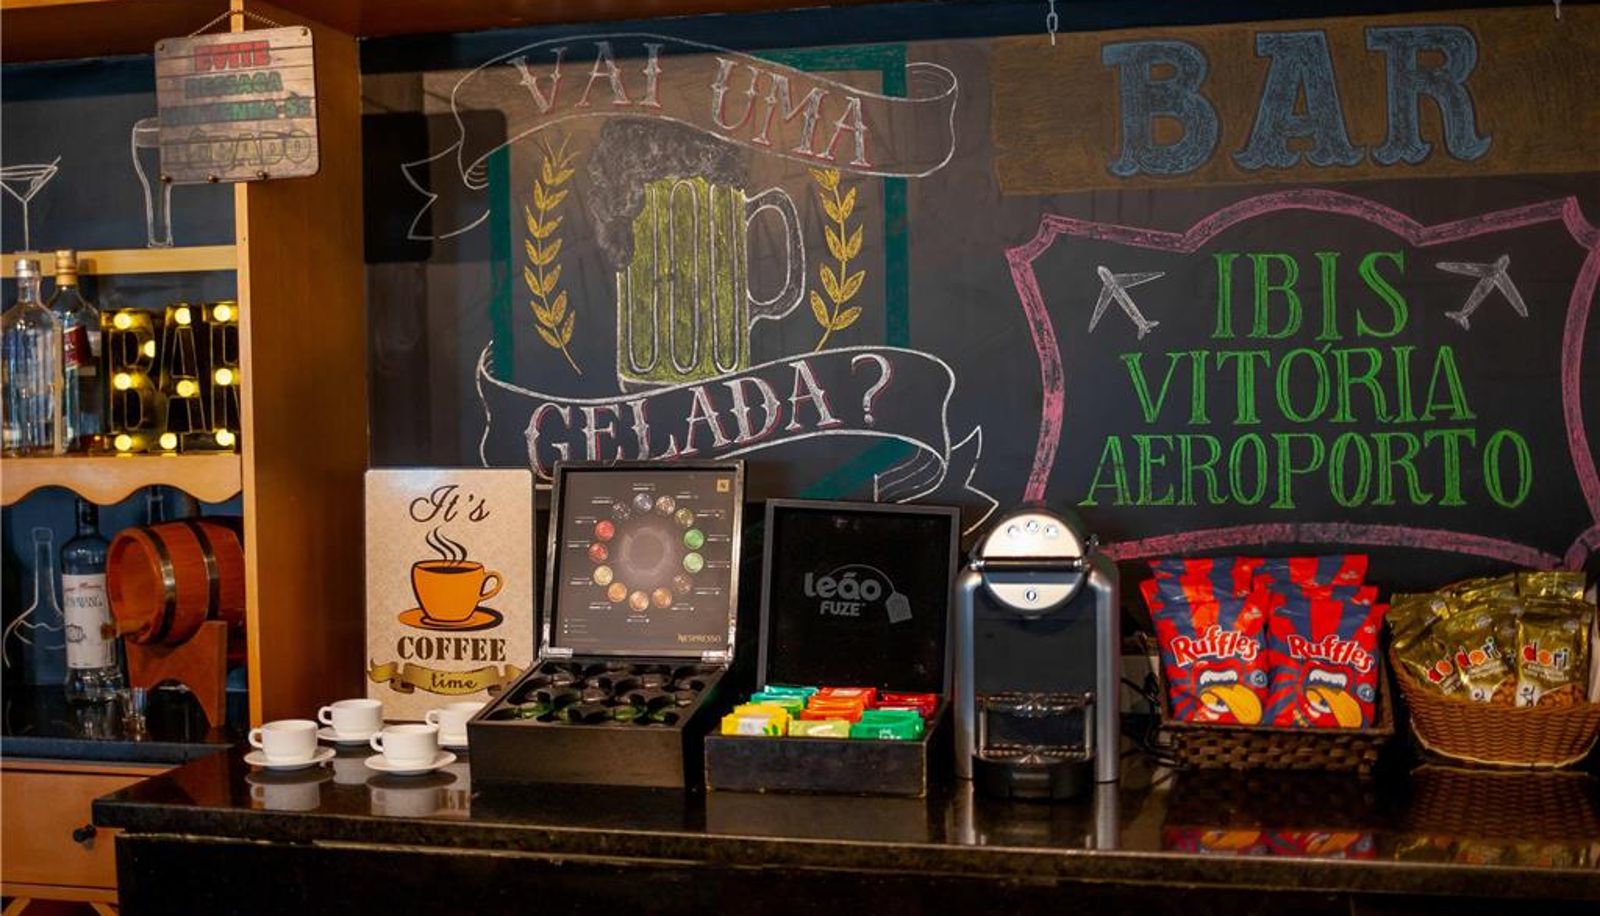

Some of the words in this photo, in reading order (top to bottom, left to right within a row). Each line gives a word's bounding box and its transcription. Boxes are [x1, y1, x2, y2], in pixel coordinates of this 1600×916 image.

[505, 41, 664, 114] VAI
[710, 57, 875, 168] UMA
[1102, 24, 1493, 178] BAR
[1210, 249, 1410, 341] IBIS
[1119, 342, 1477, 425] VITÓRIA
[1077, 428, 1534, 510] AEROPORTO
[409, 484, 490, 523] It's
[803, 572, 882, 601] leão
[820, 601, 861, 616] FUZE
[396, 635, 506, 662] COFFEE
[1170, 624, 1261, 667] Ruffles
[1287, 634, 1375, 672] Ruffles
[1522, 640, 1569, 667] dori
[430, 672, 479, 690] time
[1426, 658, 1454, 684] do
